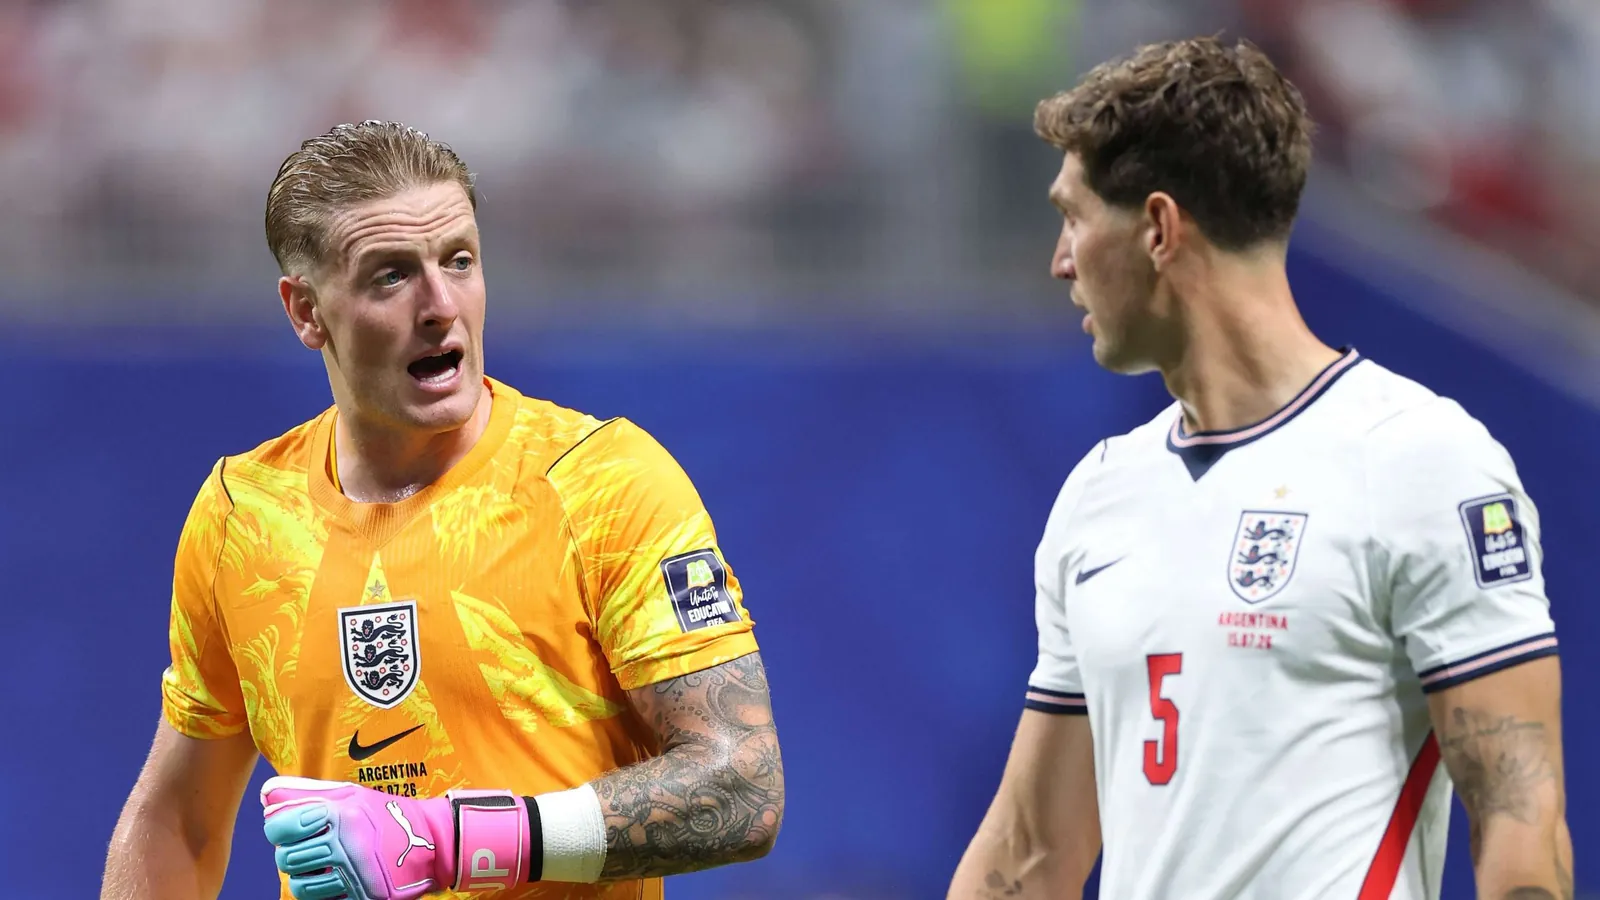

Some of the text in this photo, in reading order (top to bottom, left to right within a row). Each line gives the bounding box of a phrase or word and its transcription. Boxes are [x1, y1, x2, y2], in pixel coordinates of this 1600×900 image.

[1142, 652, 1183, 786] 5
[358, 762, 427, 782] ARGENTINA
[372, 783, 417, 798] 07.26
